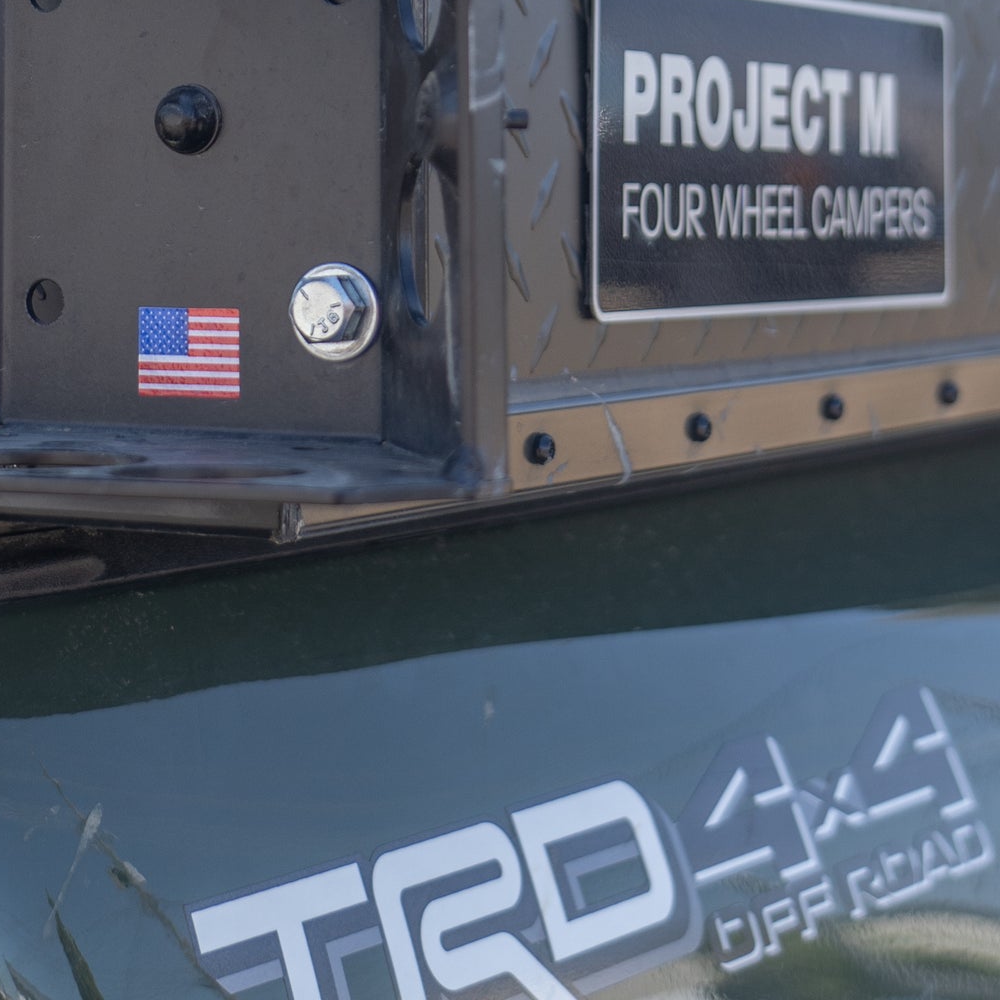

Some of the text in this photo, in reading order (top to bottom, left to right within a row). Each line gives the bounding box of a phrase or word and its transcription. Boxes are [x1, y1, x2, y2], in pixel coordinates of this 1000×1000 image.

[623, 50, 898, 157] PROJECT M
[622, 183, 934, 240] FOUR WHEEL CAMPERS
[190, 779, 676, 1000] TRD
[712, 819, 995, 974] OFF ROAD
